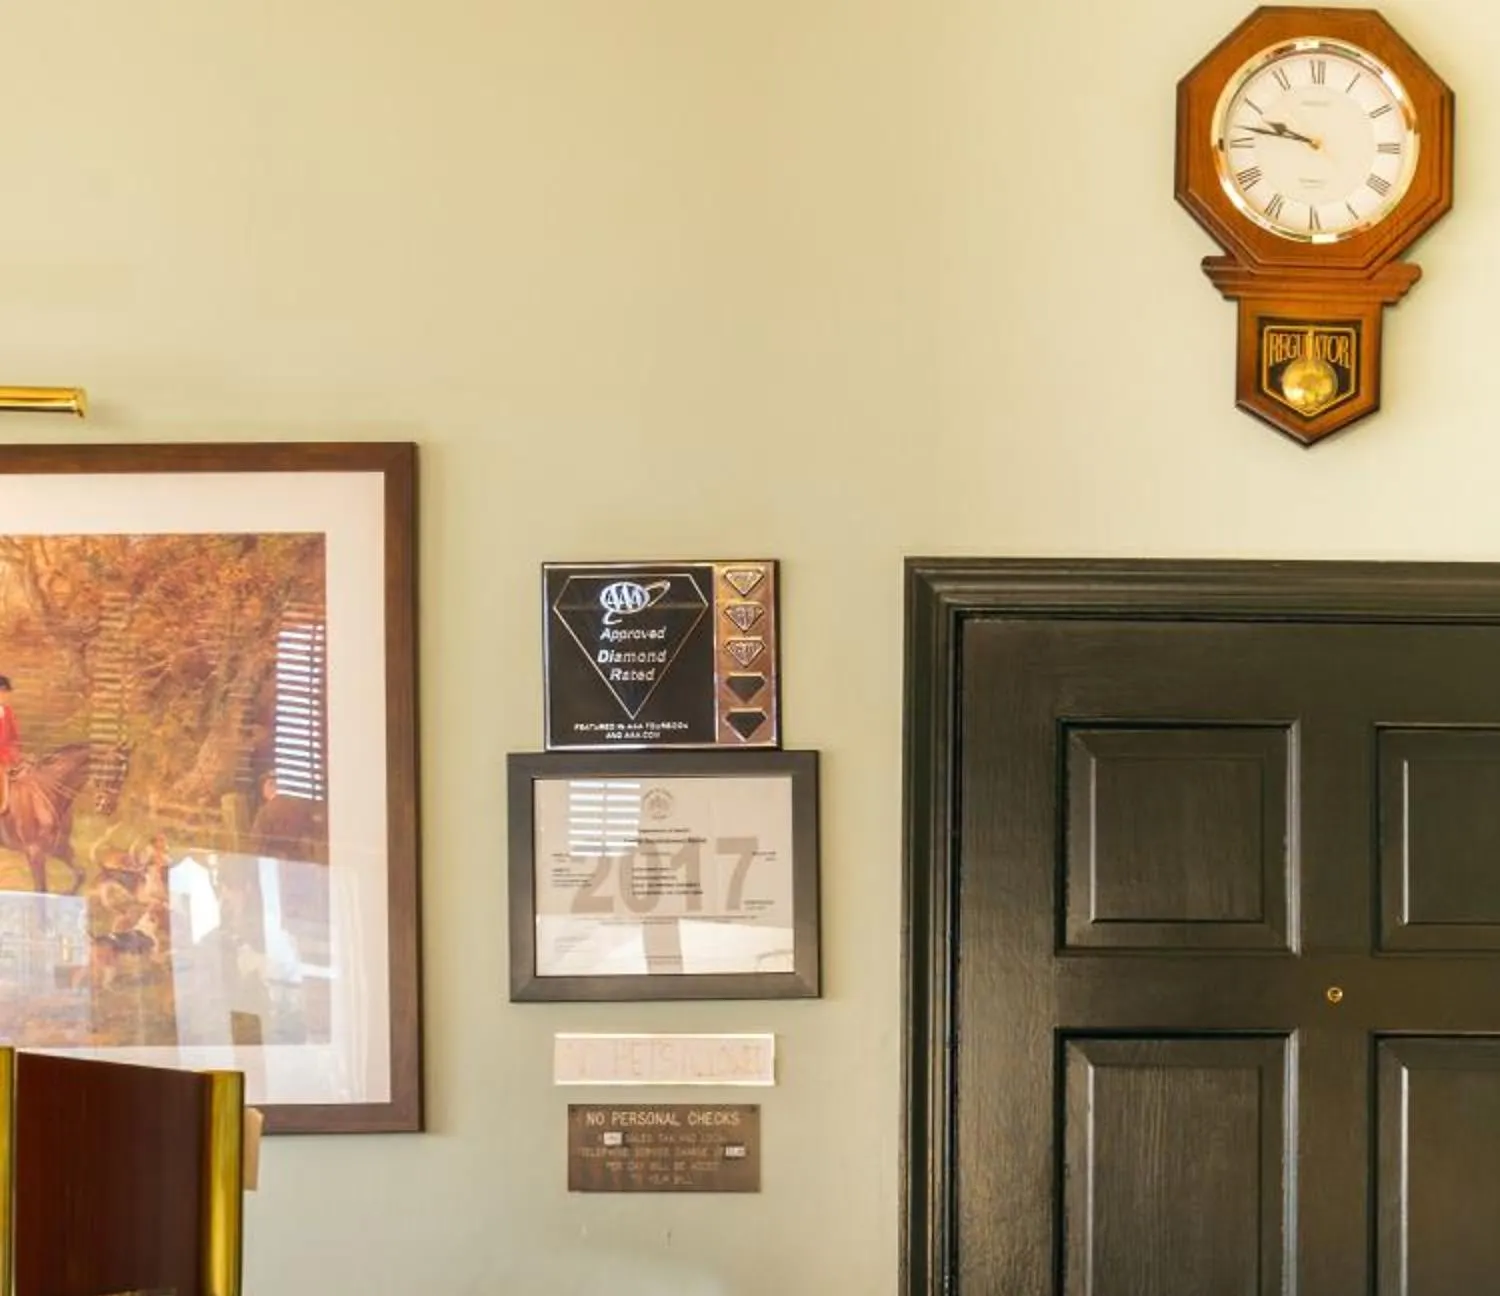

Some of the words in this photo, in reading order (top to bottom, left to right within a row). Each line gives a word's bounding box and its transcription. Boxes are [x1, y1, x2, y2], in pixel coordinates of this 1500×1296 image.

[1269, 333, 1350, 369] REGUATOR
[600, 626, 668, 643] Approved
[597, 648, 668, 663] Diamond
[610, 667, 656, 681] Rated
[569, 836, 759, 915] 2017
[587, 1111, 605, 1126] NO
[611, 1111, 681, 1126] PERSONAL
[687, 1111, 741, 1126] CHECKS
